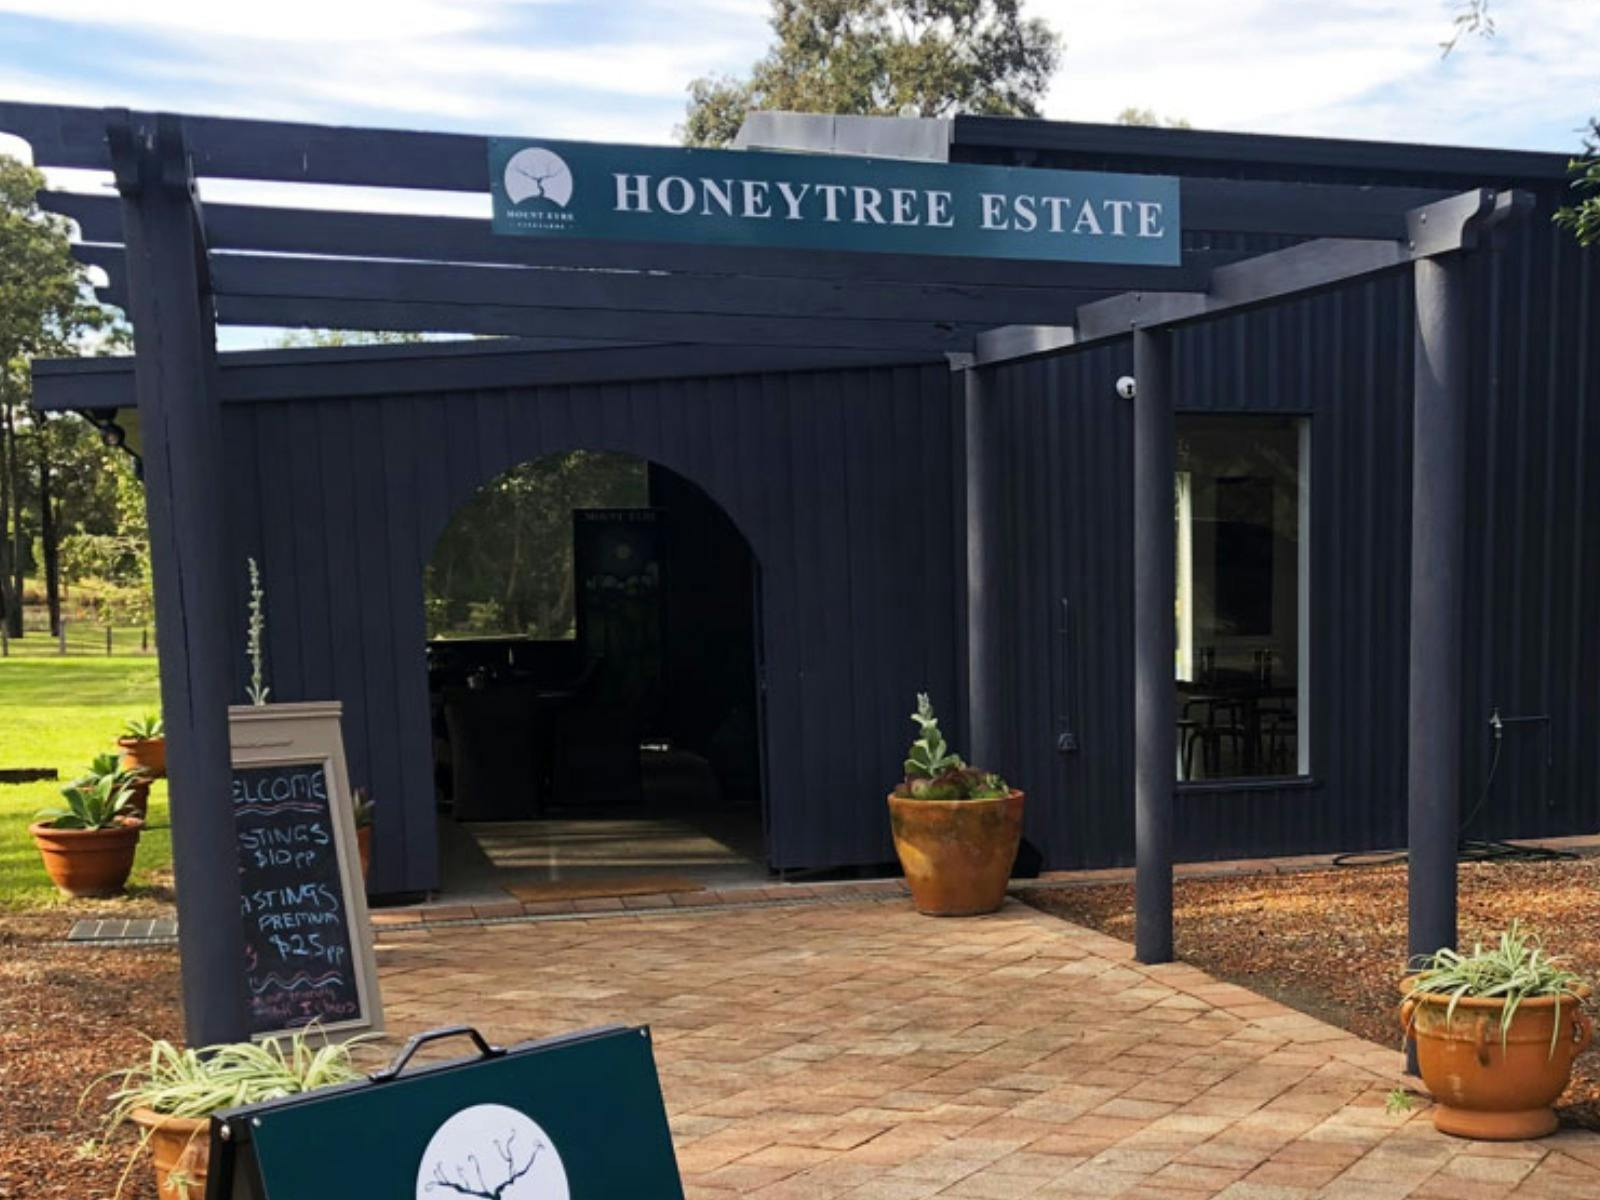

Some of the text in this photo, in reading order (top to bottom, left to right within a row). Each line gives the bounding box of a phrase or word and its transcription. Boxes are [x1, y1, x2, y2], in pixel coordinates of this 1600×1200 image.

[613, 172, 1165, 238] HONEYTREE ESTATE
[232, 769, 327, 803] ELCOME
[238, 824, 329, 849] STINGS
[240, 883, 340, 915] ASTINGS
